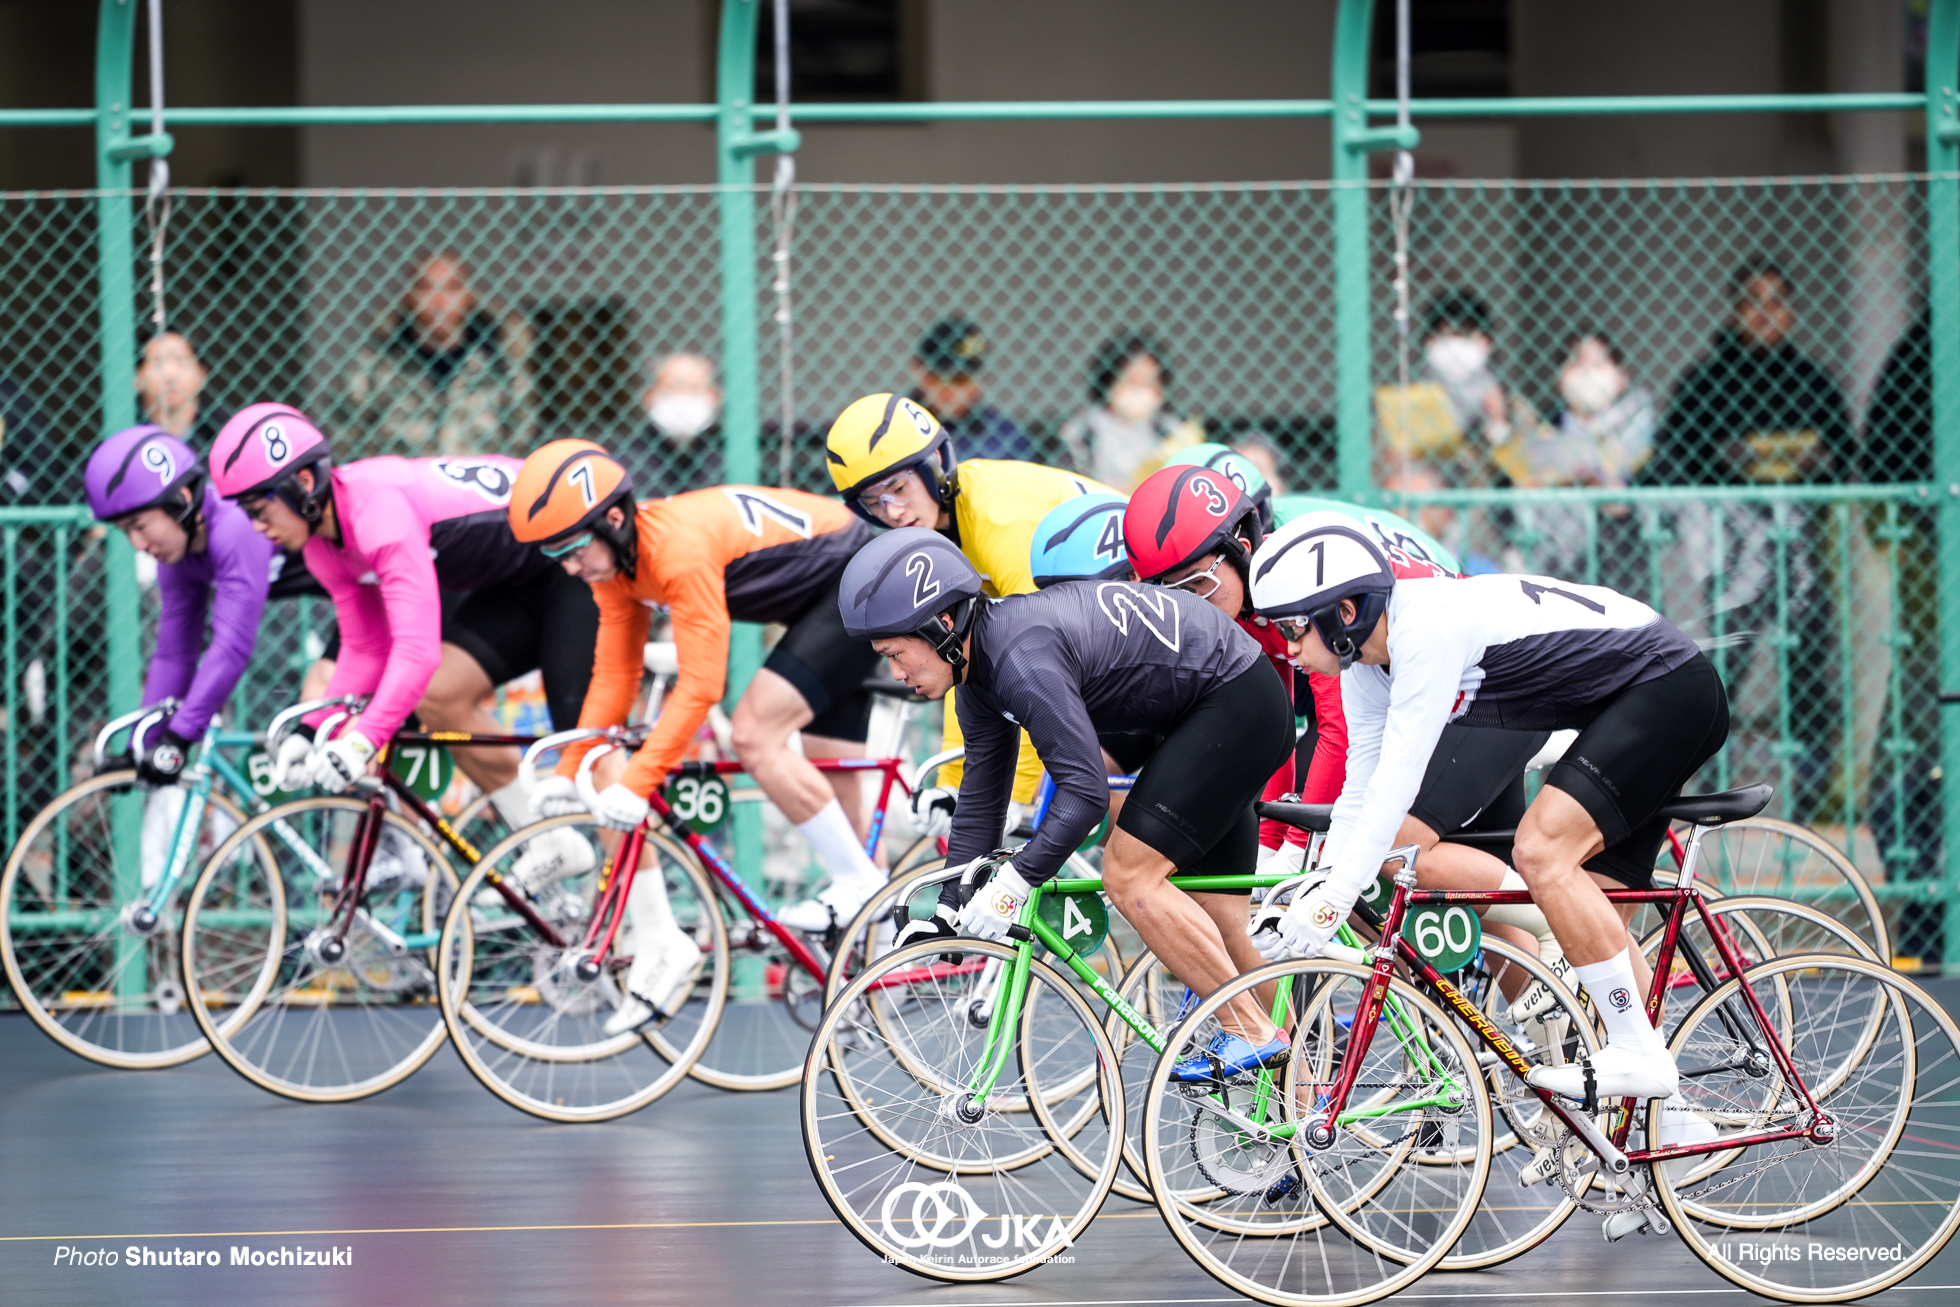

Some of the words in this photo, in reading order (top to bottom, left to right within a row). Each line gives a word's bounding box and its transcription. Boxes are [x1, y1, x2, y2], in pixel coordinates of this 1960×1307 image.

[902, 400, 934, 438] 5
[142, 442, 175, 485] 9
[262, 422, 290, 466] 8
[432, 459, 514, 504] 8
[568, 461, 596, 507] 7
[1190, 476, 1228, 516] 3
[1222, 459, 1248, 494] 6
[724, 489, 811, 539] 7
[1094, 512, 1125, 564] 4
[906, 552, 940, 609] 2
[944, 572, 970, 590] KEIRIN
[1308, 541, 1325, 587] 1
[1097, 583, 1179, 653] 2
[1520, 580, 1606, 615] 1
[248, 752, 289, 797] 5
[401, 748, 440, 790] 71
[1577, 756, 1601, 778] PEARL
[672, 777, 723, 823] 36
[1063, 896, 1093, 940] 4
[1415, 906, 1472, 958] 60
[1436, 979, 1532, 1075] CHERUBIM
